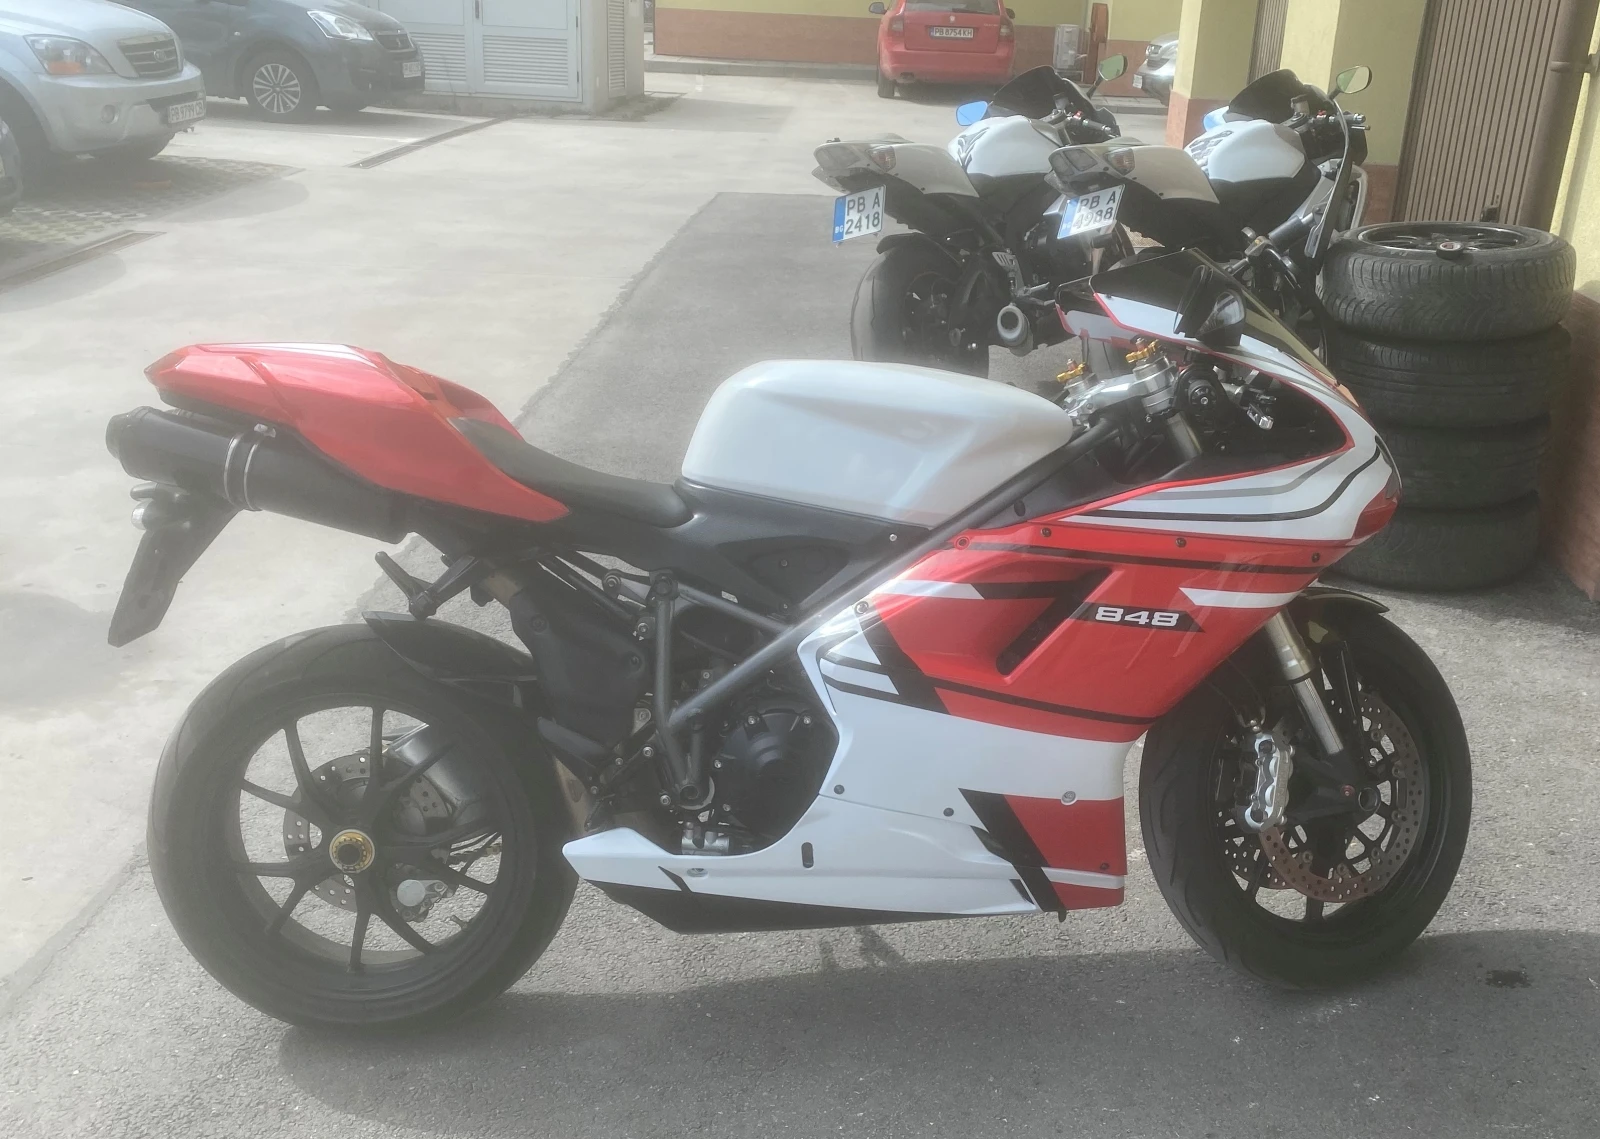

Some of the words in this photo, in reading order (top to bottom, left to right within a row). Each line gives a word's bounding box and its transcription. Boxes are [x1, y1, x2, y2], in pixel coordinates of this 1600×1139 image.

[934, 27, 944, 36] PB
[945, 28, 962, 36] 8754
[962, 29, 973, 37] KH
[847, 196, 866, 217] PB
[872, 192, 880, 209] A
[1077, 195, 1100, 213] PB
[1106, 191, 1116, 205] A
[845, 211, 880, 235] 2418
[1072, 206, 1114, 229] 4988
[1095, 606, 1180, 627] 848
